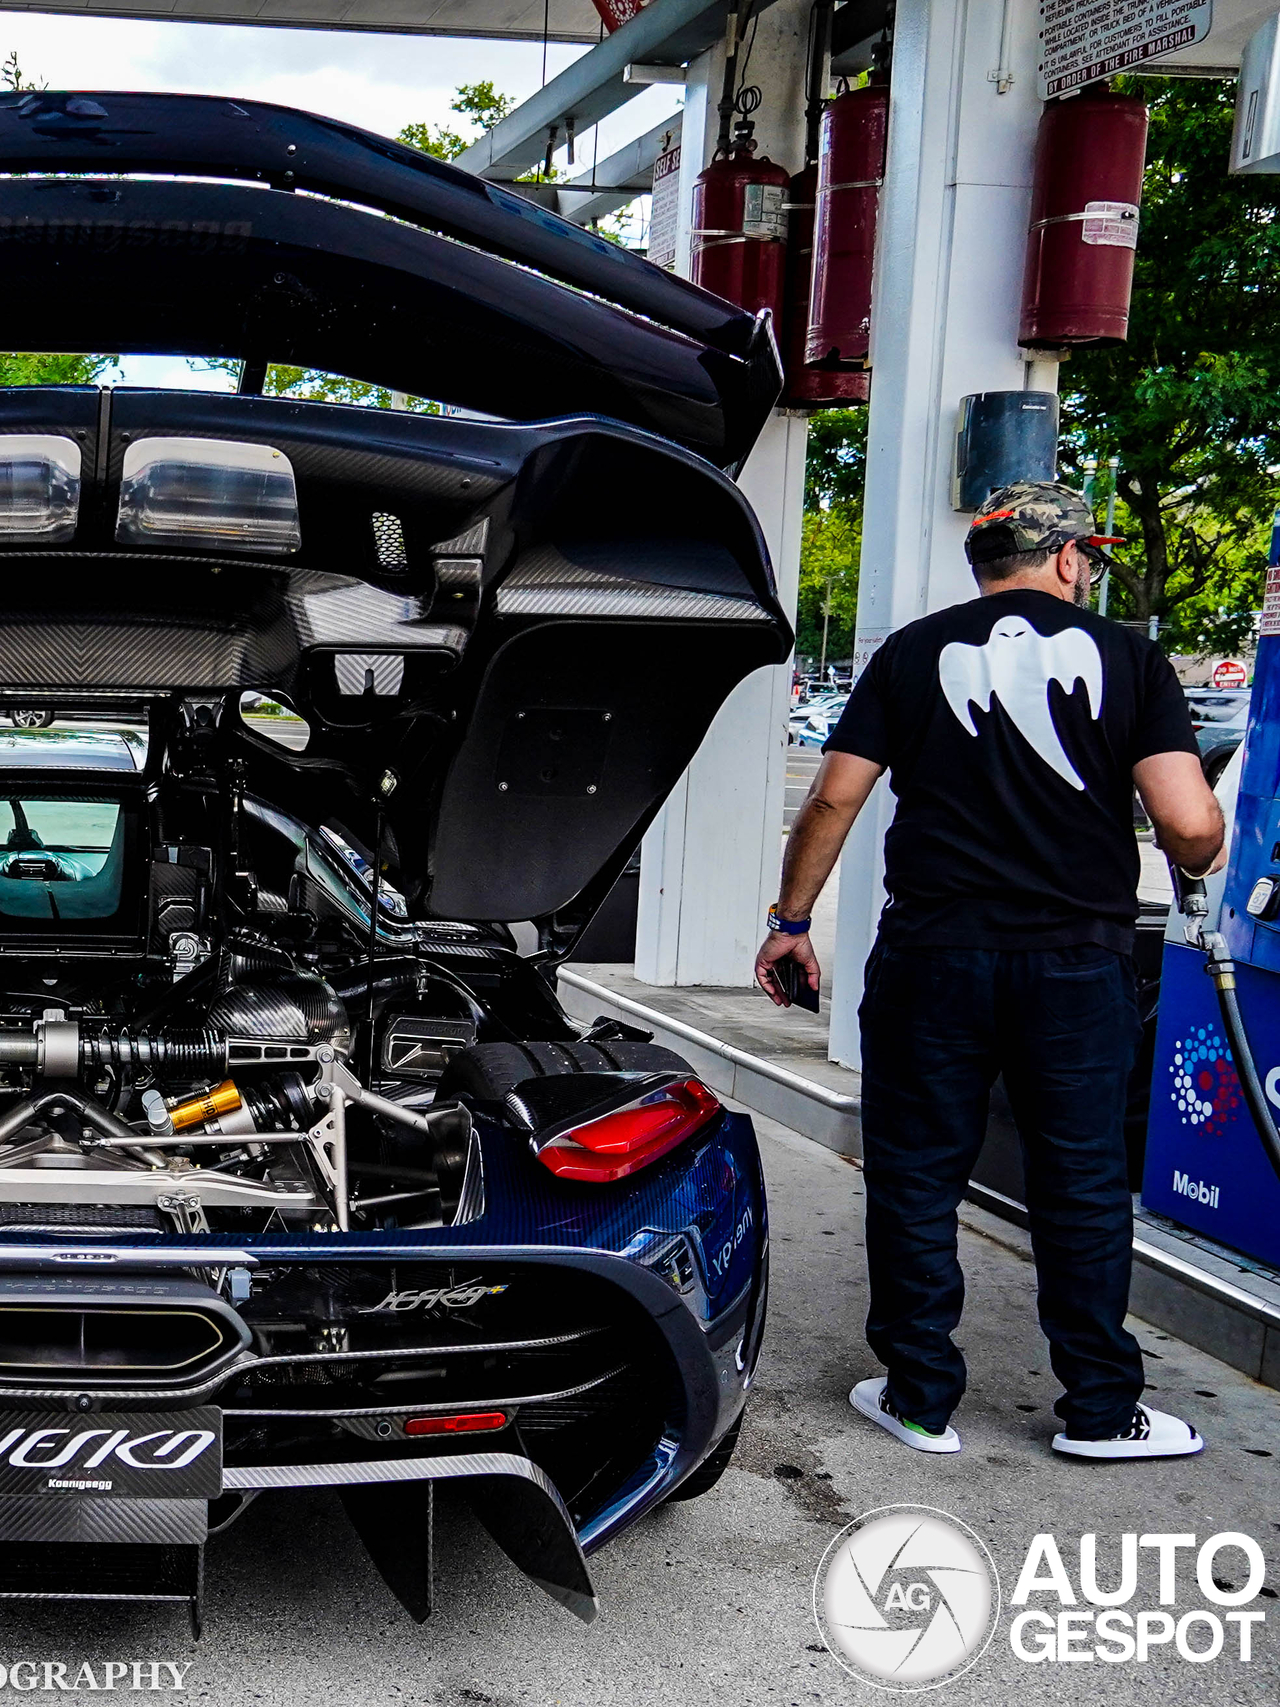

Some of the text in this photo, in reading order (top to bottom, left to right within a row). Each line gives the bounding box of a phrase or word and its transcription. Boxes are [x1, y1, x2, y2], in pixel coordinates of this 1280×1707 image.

[1044, 18, 1072, 37] PORTABLE
[1073, 2, 1111, 24] CONTAINERS
[1045, 34, 1061, 46] WHILE
[1063, 22, 1089, 39] LOCATED
[1091, 12, 1111, 27] INSIDE
[1113, 6, 1125, 17] THE
[1058, 46, 1087, 64] UNLAWFUL
[1090, 39, 1102, 51] FOR
[1103, 23, 1142, 45] CUSTOMERS
[1145, 18, 1154, 28] TO
[1156, 12, 1169, 24] FILL
[1089, 28, 1099, 38] OR
[1100, 18, 1121, 34] TRUCK
[1123, 13, 1136, 25] BED
[1138, 7, 1147, 18] OF
[1149, 4, 1154, 13] A
[1048, 27, 1193, 95] BY ORDER OF THE FIRE MARSHAL
[1082, 53, 1094, 64] SEE
[1095, 38, 1130, 59] ATTENDANT
[1132, 32, 1146, 45] FOR
[1173, 1170, 1220, 1209] Mobil
[48, 1478, 113, 1491] Koenigsegg
